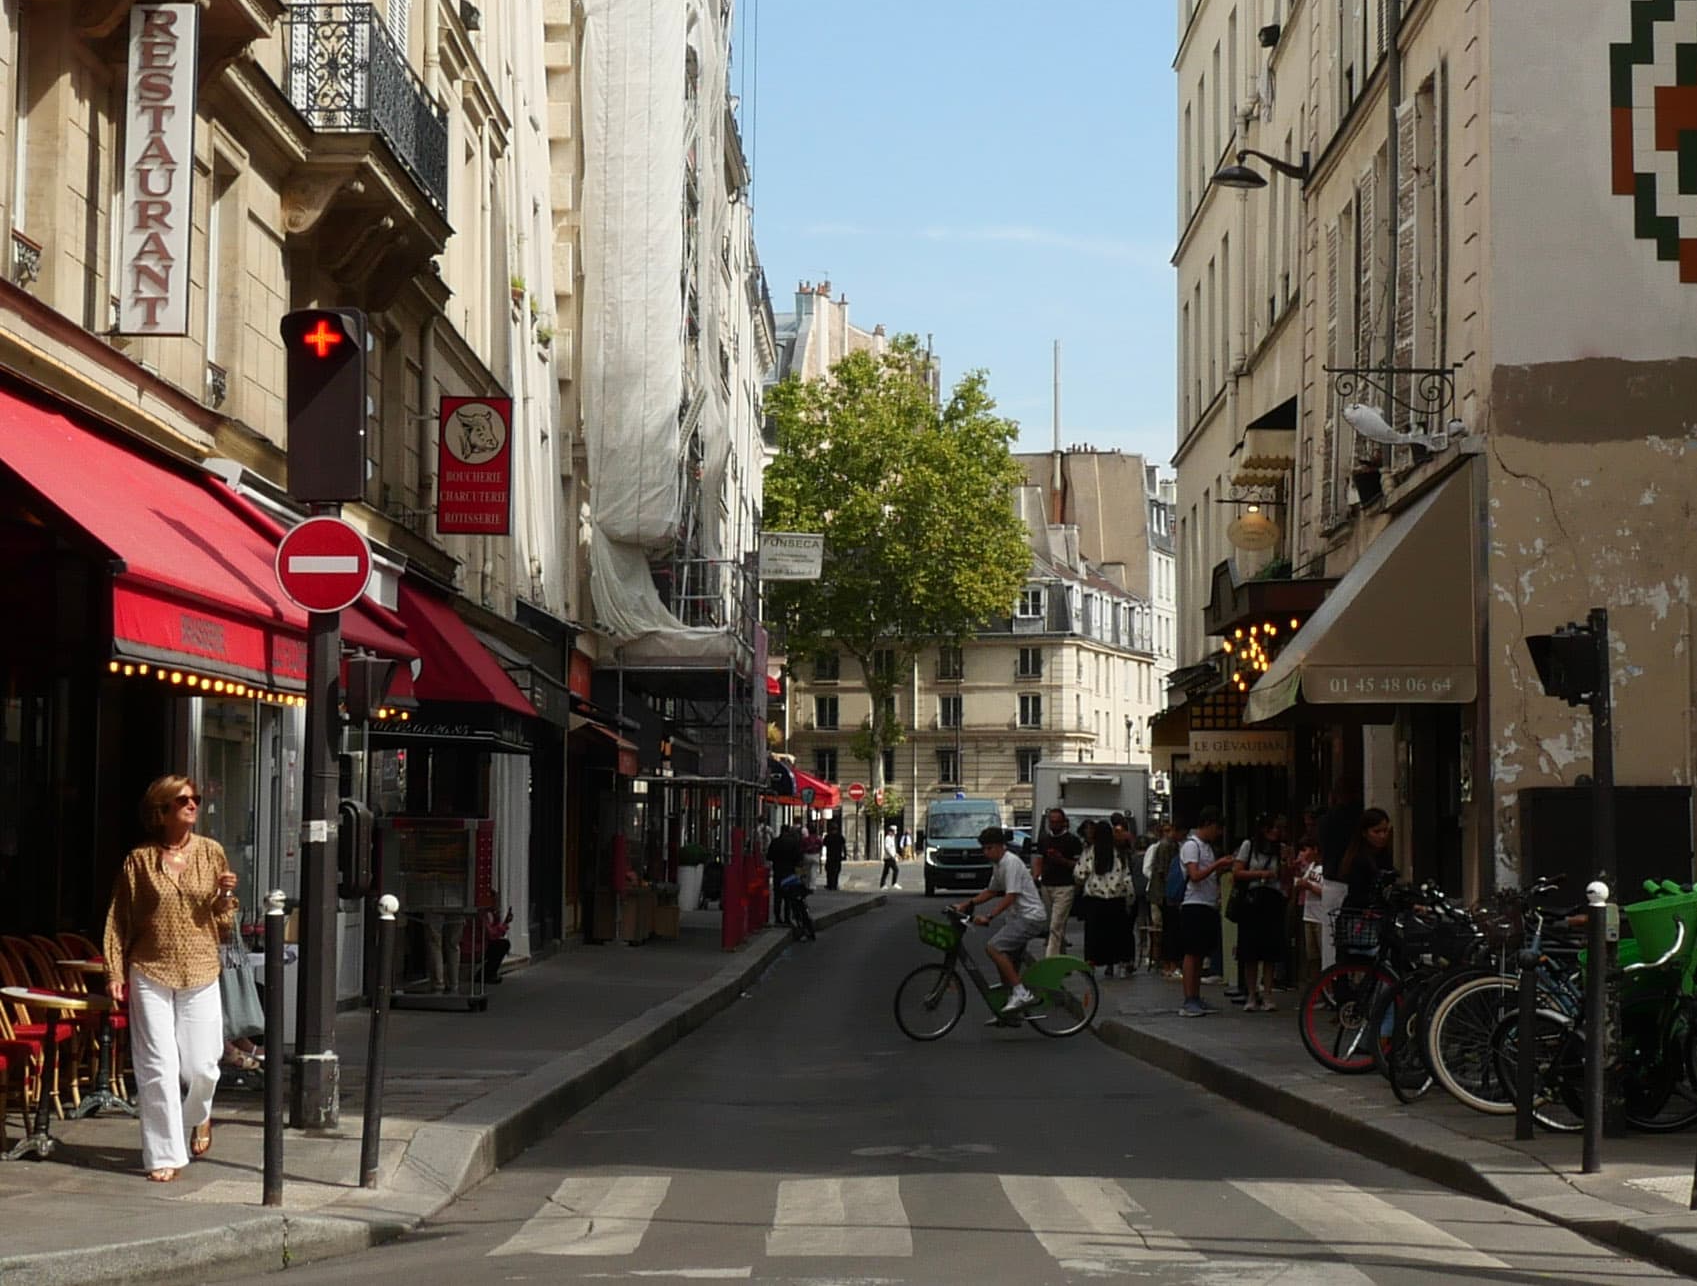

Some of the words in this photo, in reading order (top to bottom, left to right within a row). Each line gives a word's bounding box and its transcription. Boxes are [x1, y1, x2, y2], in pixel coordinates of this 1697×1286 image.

[130, 8, 180, 327] RESTAURANT
[446, 471, 503, 483] BOUCHERIE
[440, 490, 507, 502] CHARCUTERIE
[763, 537, 820, 548] FONSECA
[1329, 677, 1349, 692] 01
[1355, 677, 1375, 692] 45
[1380, 677, 1400, 692] 48
[1406, 677, 1426, 692] 06
[1431, 677, 1452, 692] 64
[1194, 741, 1209, 752] LE
